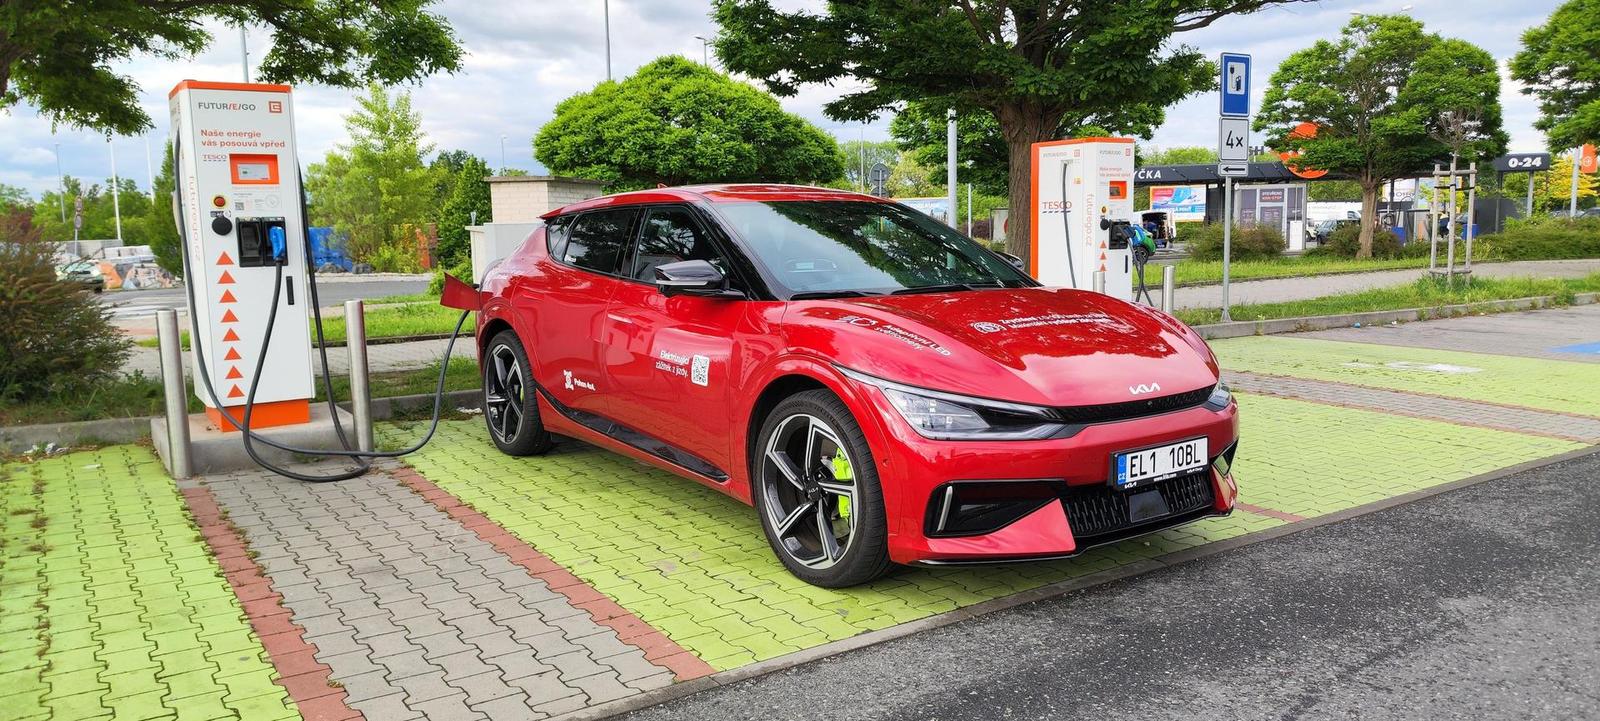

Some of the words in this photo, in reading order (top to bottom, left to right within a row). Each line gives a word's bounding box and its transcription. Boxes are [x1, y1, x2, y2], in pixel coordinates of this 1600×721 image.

[201, 128, 225, 138] Naše
[226, 131, 262, 140] energie
[1225, 130, 1244, 149] 4x
[201, 139, 218, 147] vás
[220, 140, 258, 149] posouvá
[1508, 156, 1542, 168] 0-24
[1042, 201, 1072, 210] TESCO
[930, 342, 952, 356] LED
[1129, 382, 1160, 395] KIA
[1130, 451, 1156, 478] EL1
[1169, 442, 1201, 469] 10BL
[1118, 473, 1126, 481] CZ
